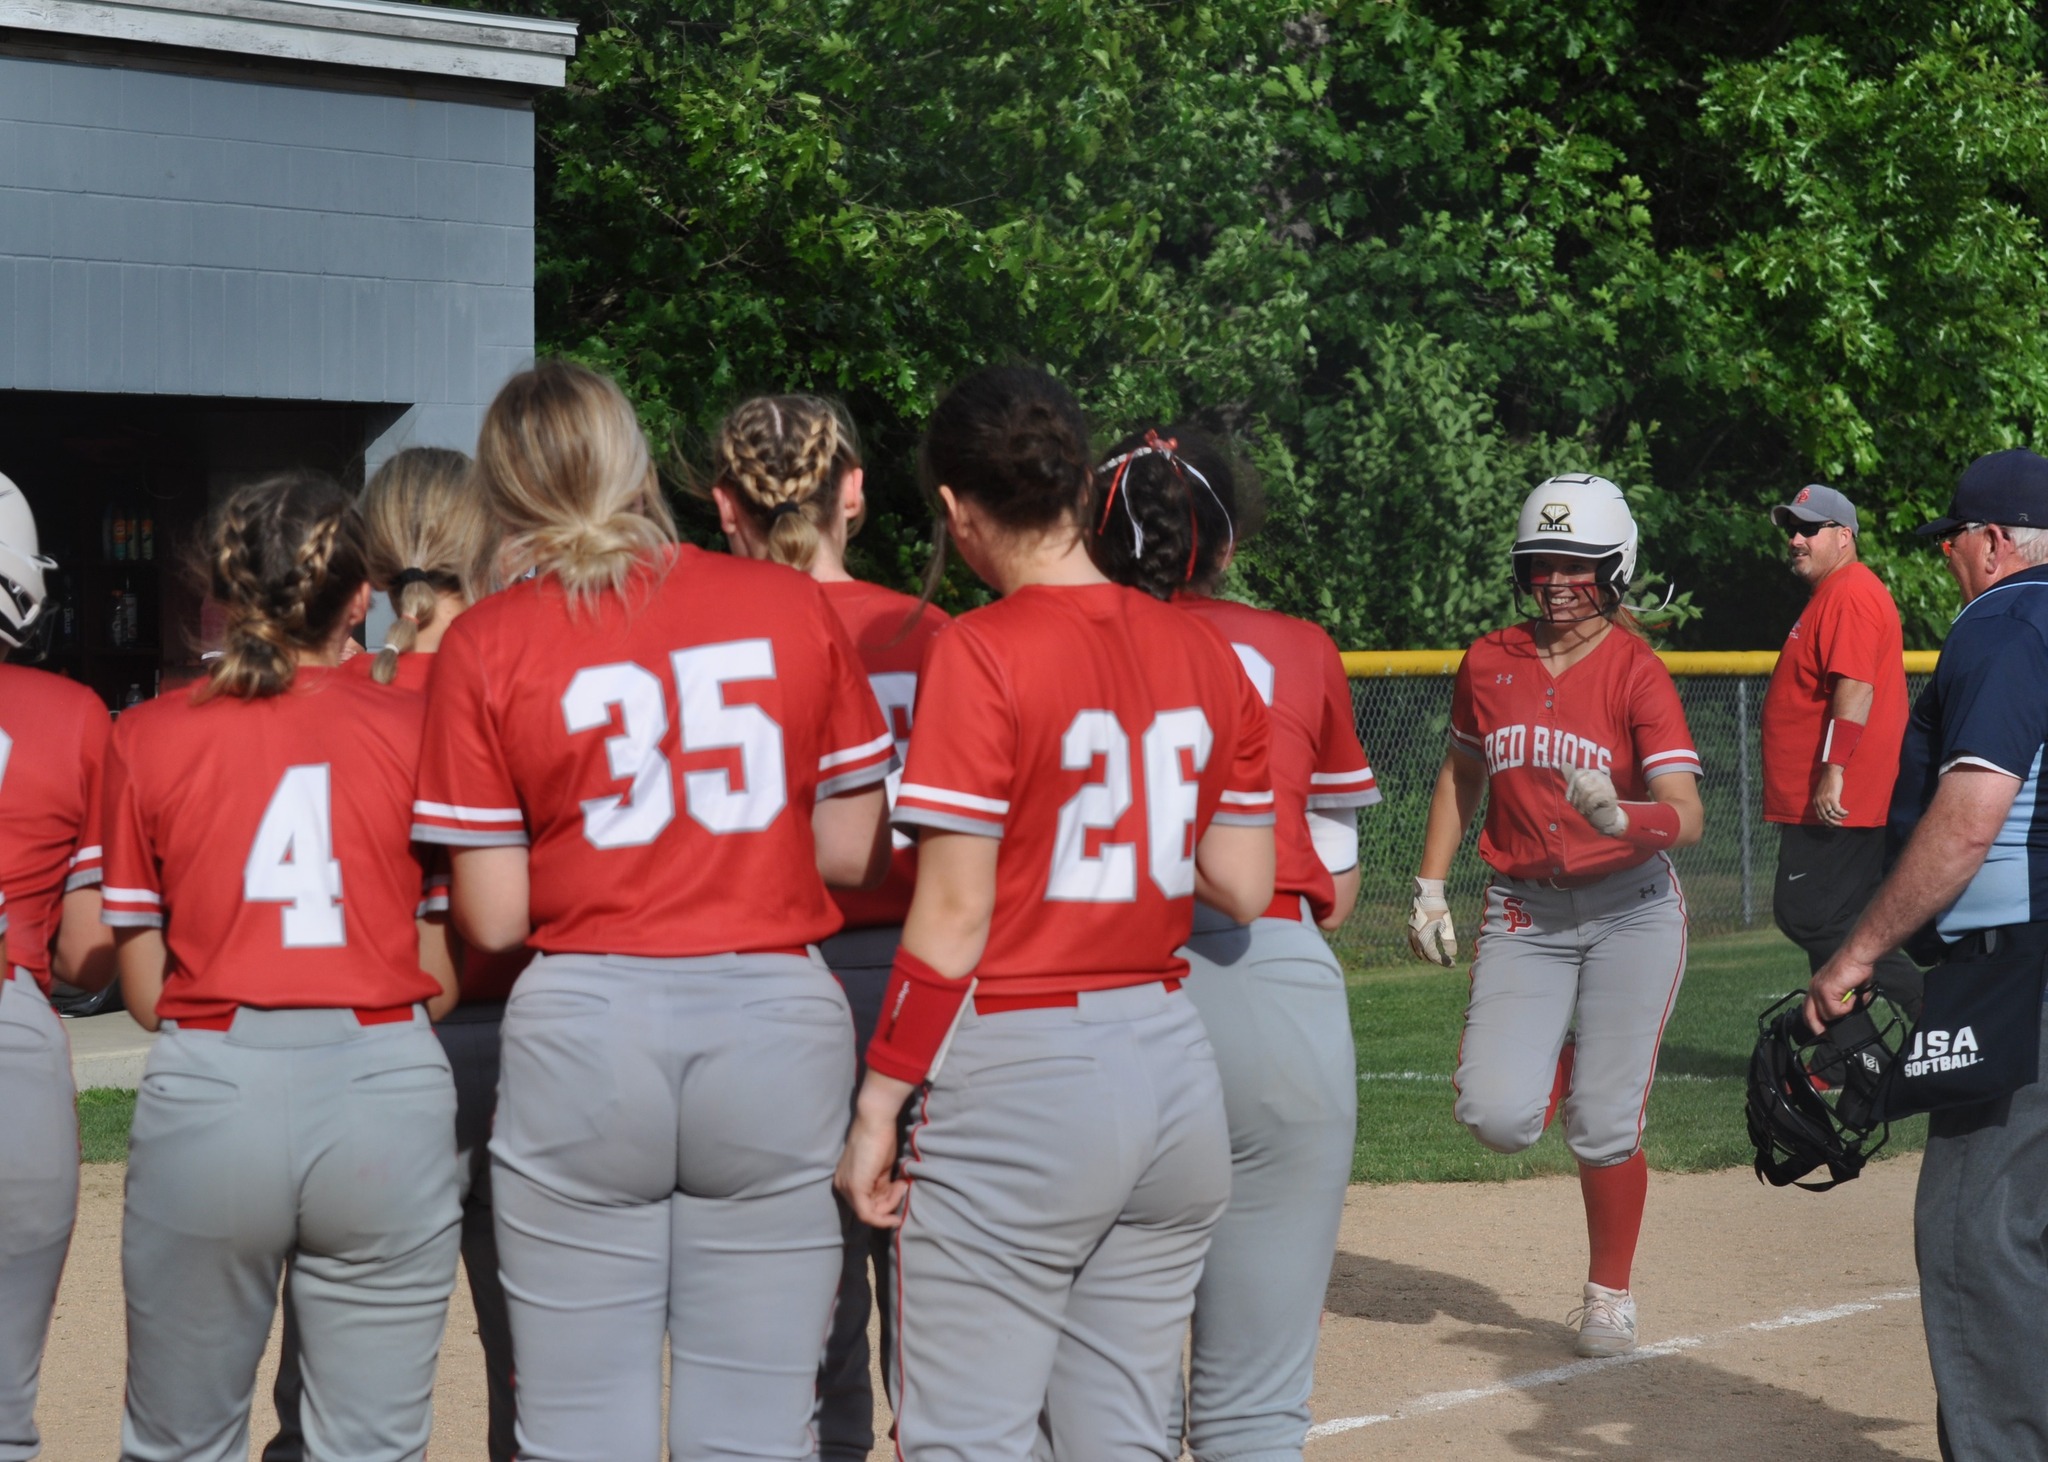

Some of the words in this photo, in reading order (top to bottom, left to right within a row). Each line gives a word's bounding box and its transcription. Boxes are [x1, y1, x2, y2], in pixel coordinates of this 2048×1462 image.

[561, 638, 787, 850] 35
[1044, 706, 1213, 901] 26
[1485, 724, 1526, 776] RED
[1533, 725, 1612, 777] RIOTS
[243, 762, 347, 948] 4
[1904, 1053, 1978, 1078] SOFTBALL
